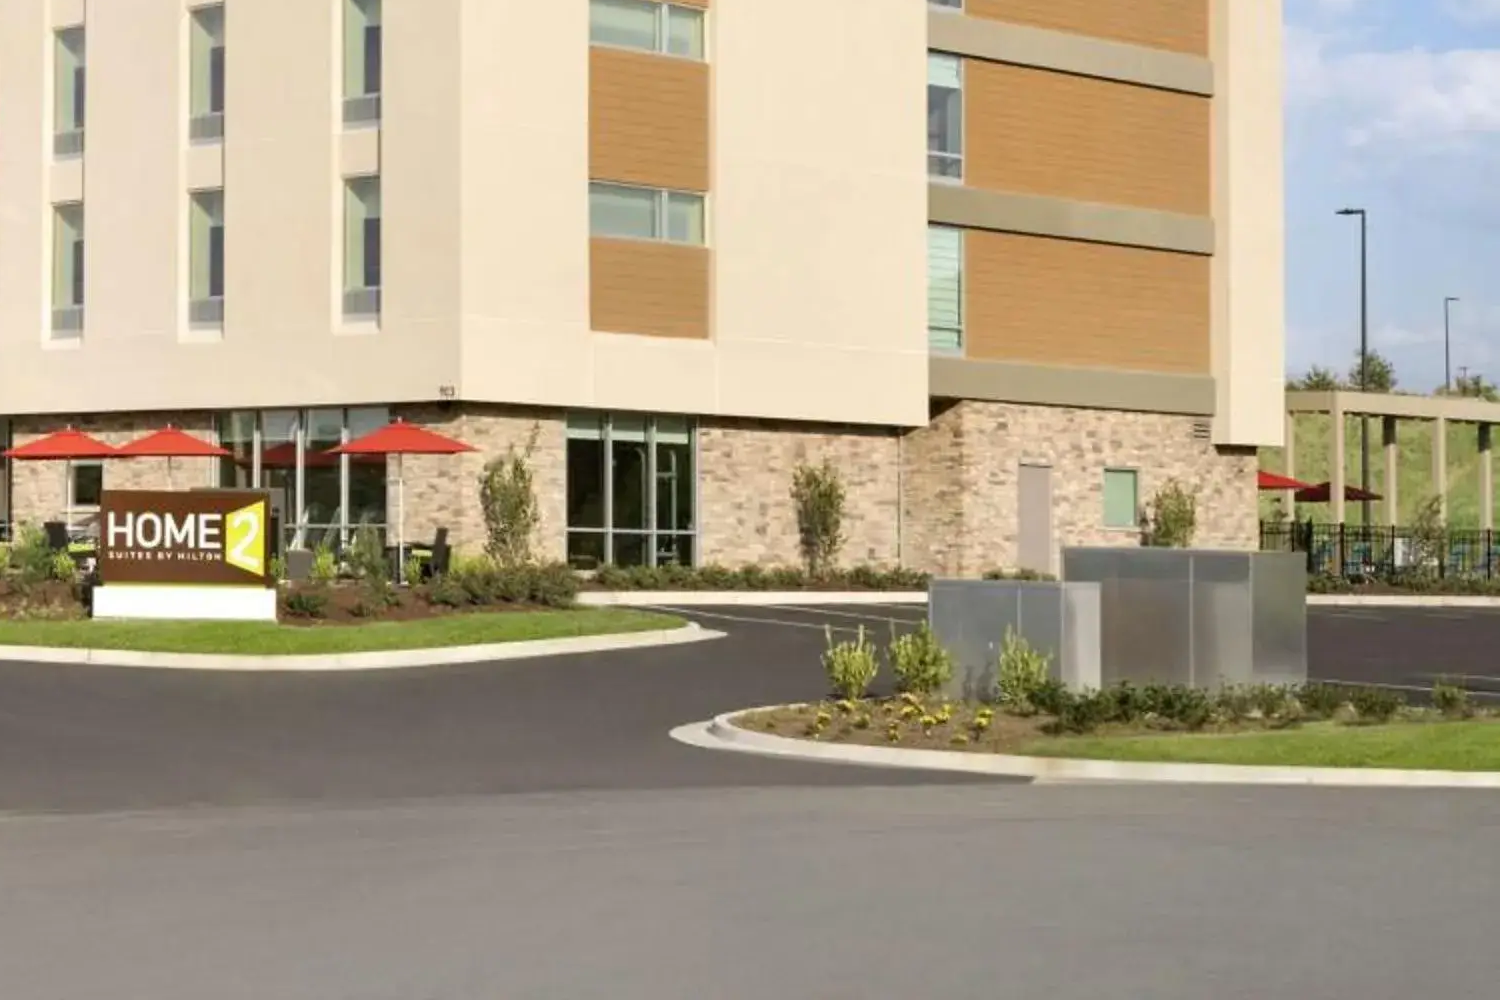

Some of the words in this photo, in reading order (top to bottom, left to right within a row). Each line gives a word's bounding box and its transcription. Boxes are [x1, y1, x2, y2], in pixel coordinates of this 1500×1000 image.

[107, 511, 223, 549] HOME
[231, 510, 260, 567] 2
[108, 551, 152, 560] SUITES
[157, 551, 173, 560] BY
[177, 551, 222, 561] HILTON
